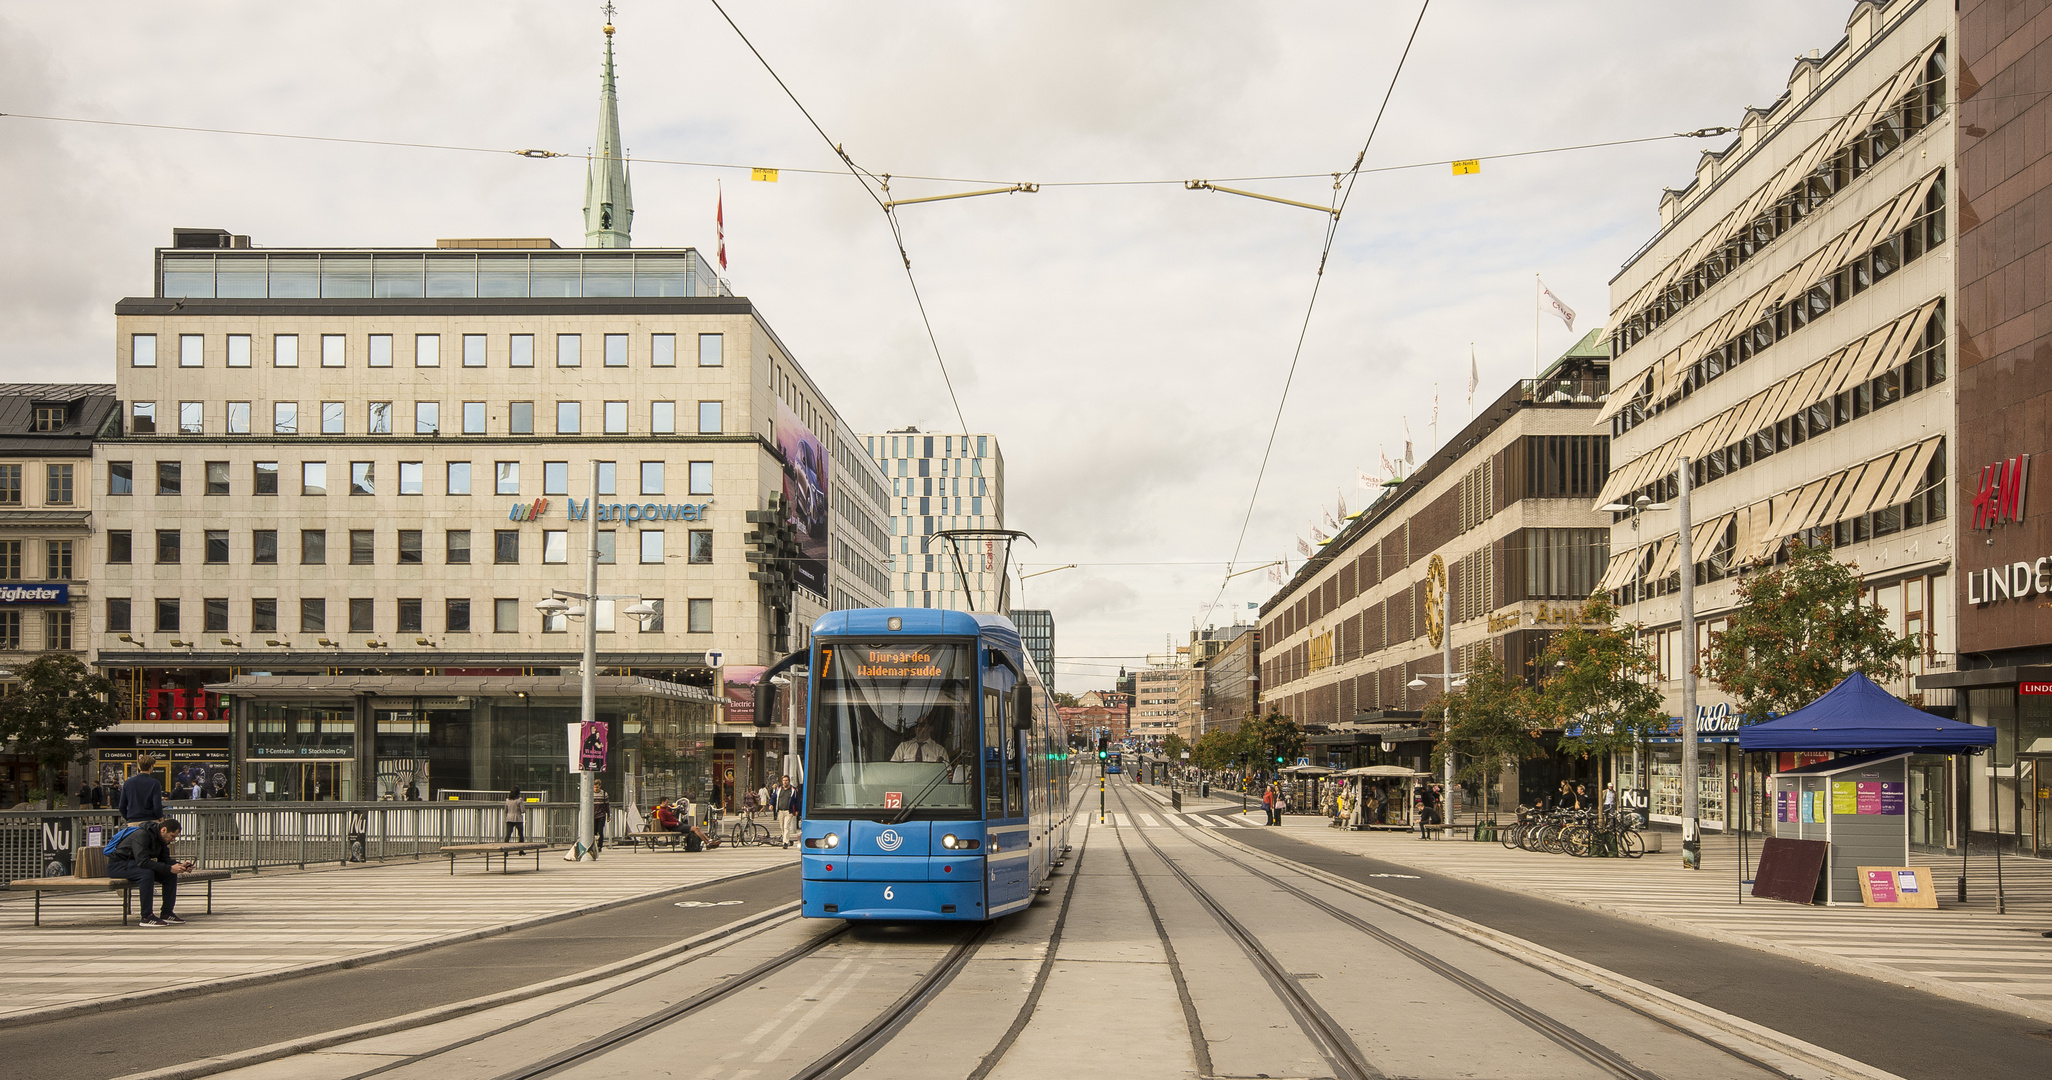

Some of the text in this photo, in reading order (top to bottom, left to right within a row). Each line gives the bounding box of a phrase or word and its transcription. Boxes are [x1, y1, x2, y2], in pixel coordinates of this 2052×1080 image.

[1972, 454, 2024, 530] H&M
[568, 498, 707, 526] Manpower
[1968, 556, 2052, 604] LINDE
[709, 653, 722, 666] T
[822, 650, 832, 677] 7
[869, 651, 931, 664] Djurgården
[857, 665, 941, 676] Waldemarsudde
[886, 799, 900, 808] 12
[1623, 791, 1648, 808] Nu
[351, 813, 366, 834] Nu
[43, 823, 69, 850] Nu
[883, 833, 896, 842] SL
[883, 886, 894, 900] 6
